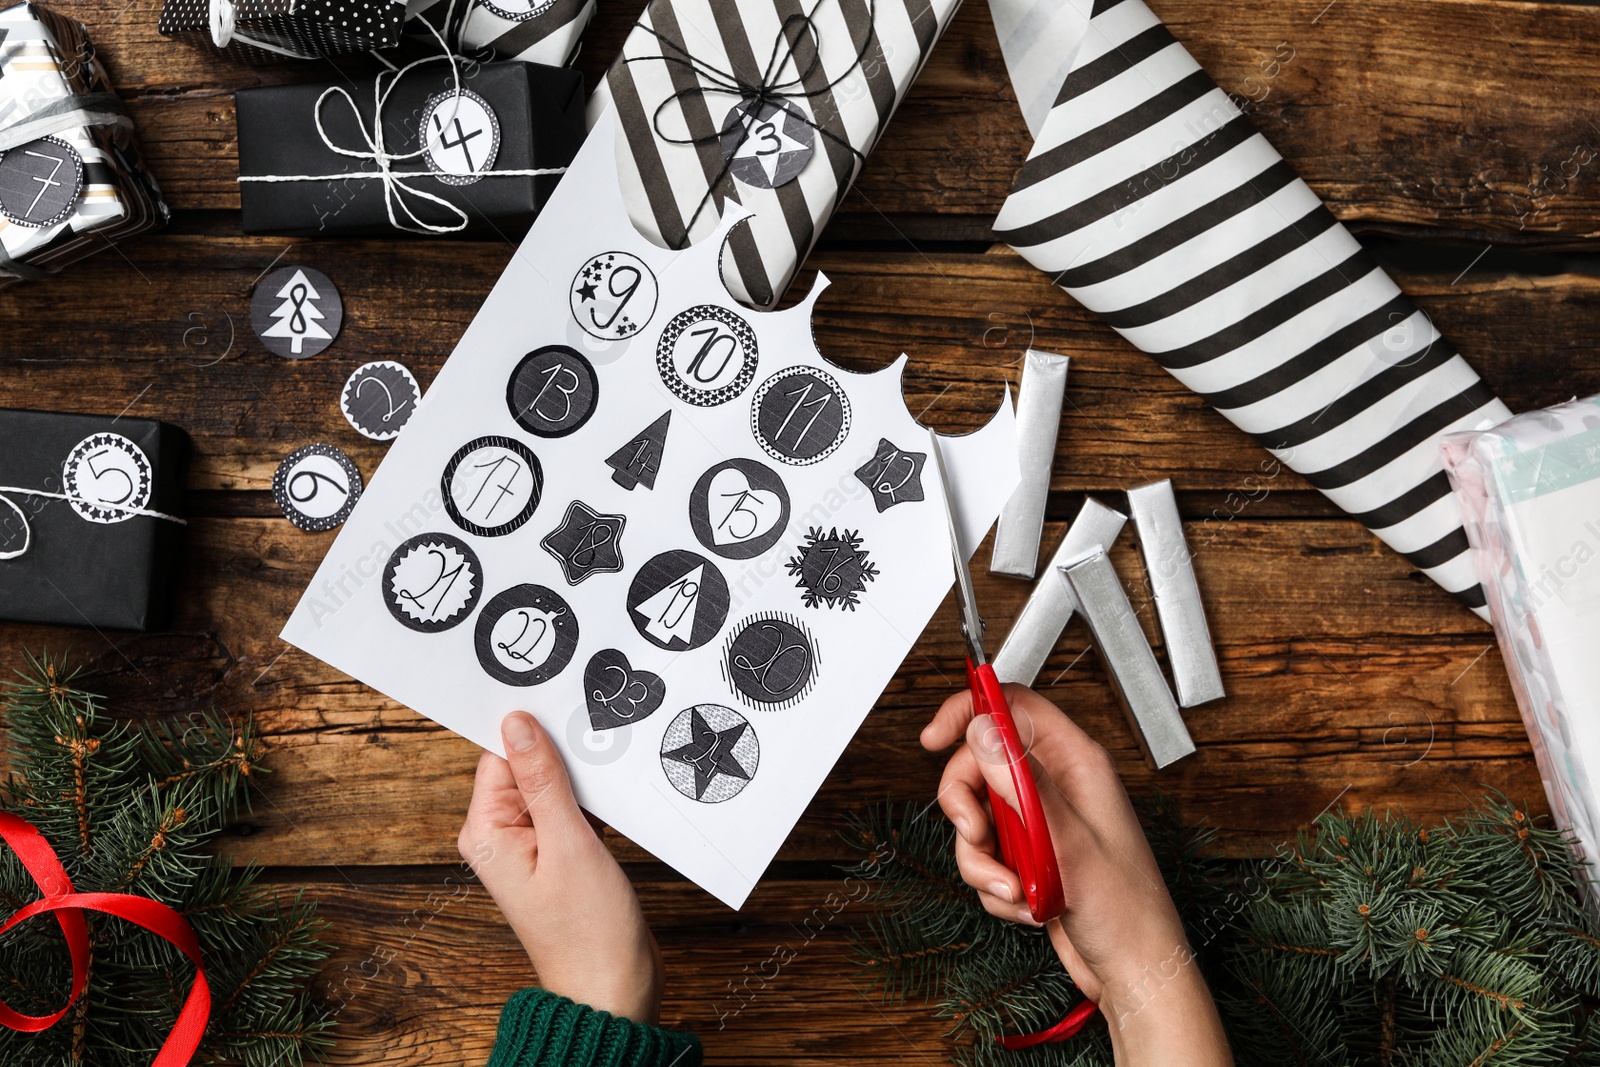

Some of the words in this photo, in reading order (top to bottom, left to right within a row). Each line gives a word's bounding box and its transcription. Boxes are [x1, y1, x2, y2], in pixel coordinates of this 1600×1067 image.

[433, 113, 483, 172] 4
[755, 122, 782, 156] 3
[24, 149, 64, 218] 7
[289, 283, 308, 334] 8
[590, 265, 641, 329] 9
[686, 327, 737, 383] 10
[356, 376, 407, 423] 2
[527, 362, 581, 423] 13
[773, 381, 833, 452] 11
[87, 449, 133, 504] 5
[624, 437, 654, 477] 14
[872, 450, 915, 503] 12
[465, 454, 521, 520] 17
[718, 490, 764, 539] 15
[567, 520, 612, 568] 18
[815, 547, 854, 593] 16
[400, 550, 465, 616] 21
[658, 577, 699, 628] 19
[497, 611, 547, 665] 22
[734, 624, 808, 695] 20
[592, 665, 648, 718] 23
[683, 731, 727, 778] 24
